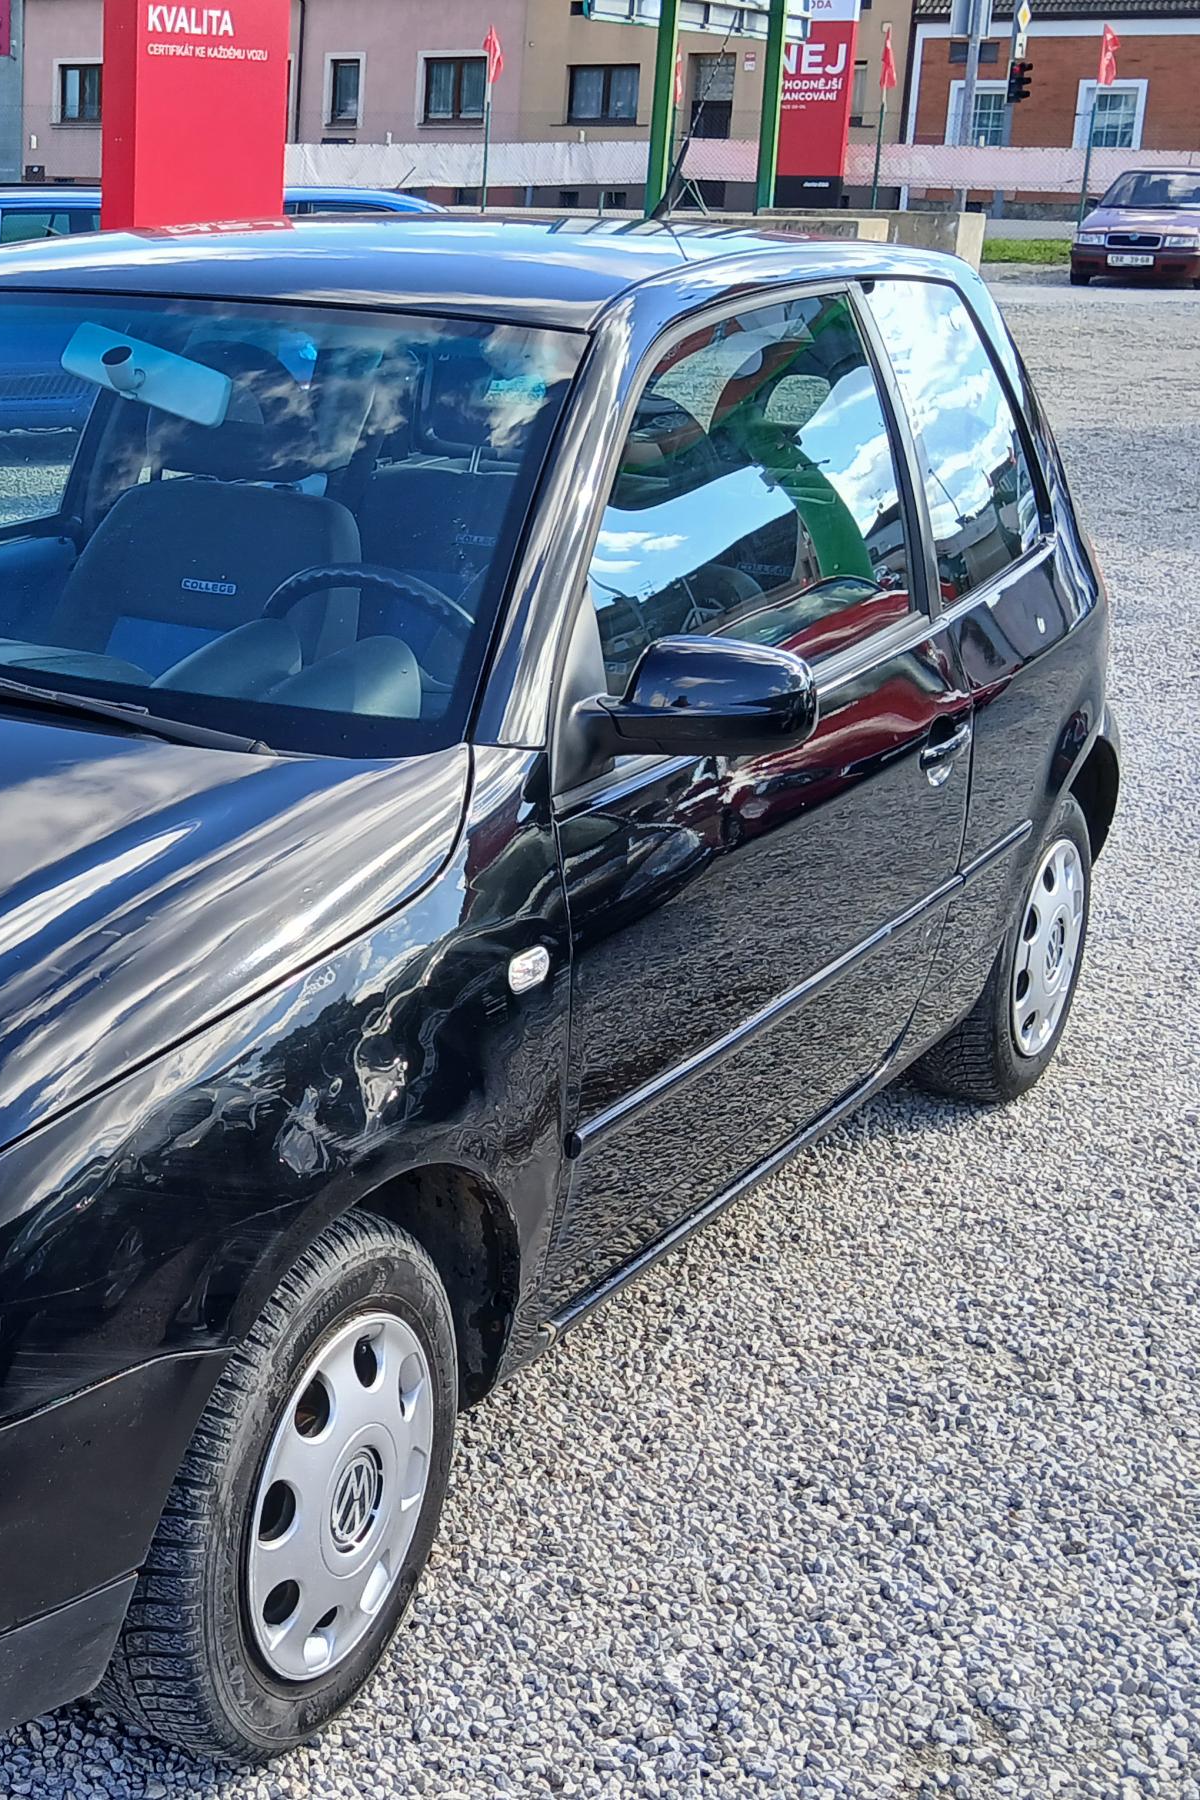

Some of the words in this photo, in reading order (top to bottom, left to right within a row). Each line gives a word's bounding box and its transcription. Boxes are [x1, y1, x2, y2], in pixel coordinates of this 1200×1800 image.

[147, 4, 235, 37] KVALITA
[147, 43, 194, 57] CERTIFIKÁT
[195, 46, 206, 58] KE
[207, 45, 246, 60] KAŽDÉMU
[246, 48, 268, 61] VOZU
[782, 78, 843, 90] HODNĚJŠÍ
[781, 90, 837, 101] ANCOVÁNÍ
[182, 579, 236, 594] COLLEGE
